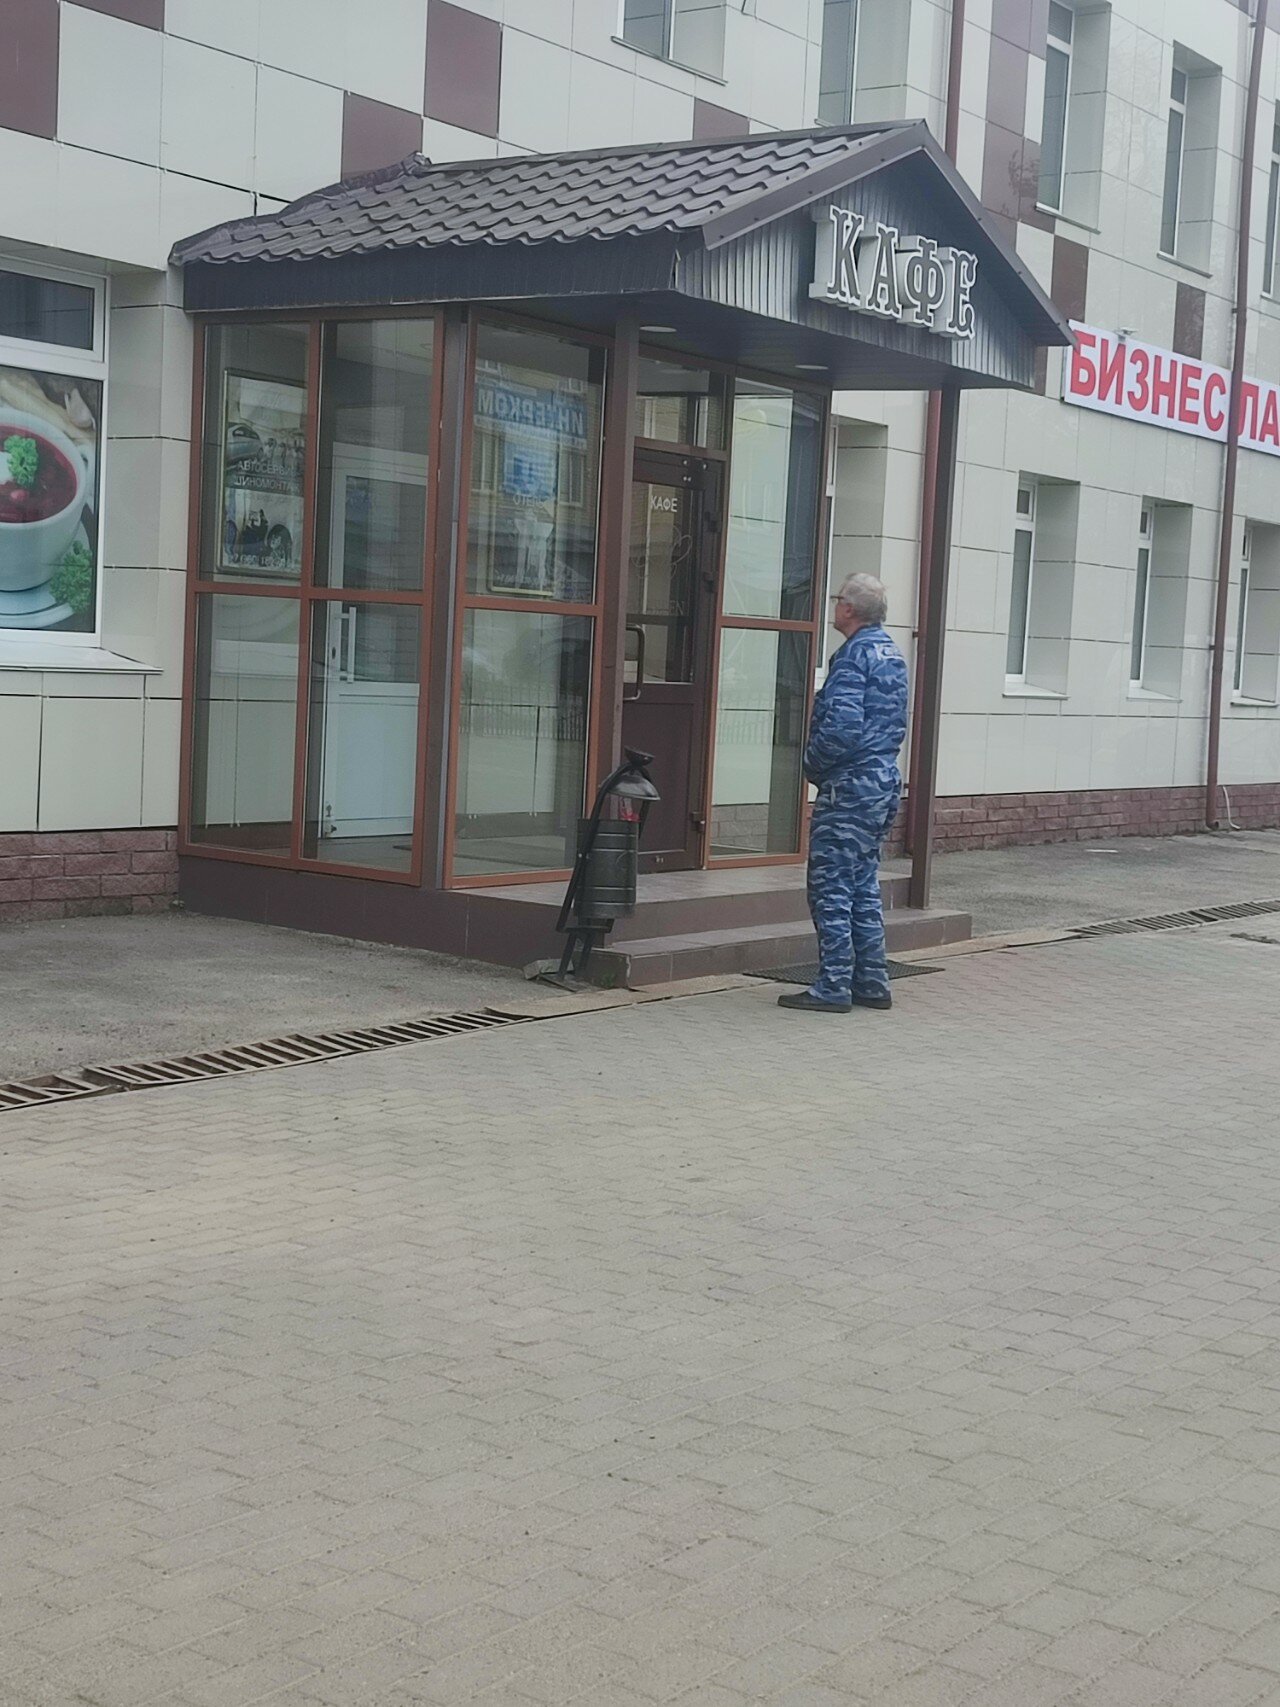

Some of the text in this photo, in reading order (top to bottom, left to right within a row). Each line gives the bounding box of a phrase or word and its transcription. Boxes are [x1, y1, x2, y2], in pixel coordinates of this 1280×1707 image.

[826, 204, 978, 341] КАФЕ
[1070, 329, 1227, 432] БИЗНЕС
[651, 495, 678, 513] КАФЕ
